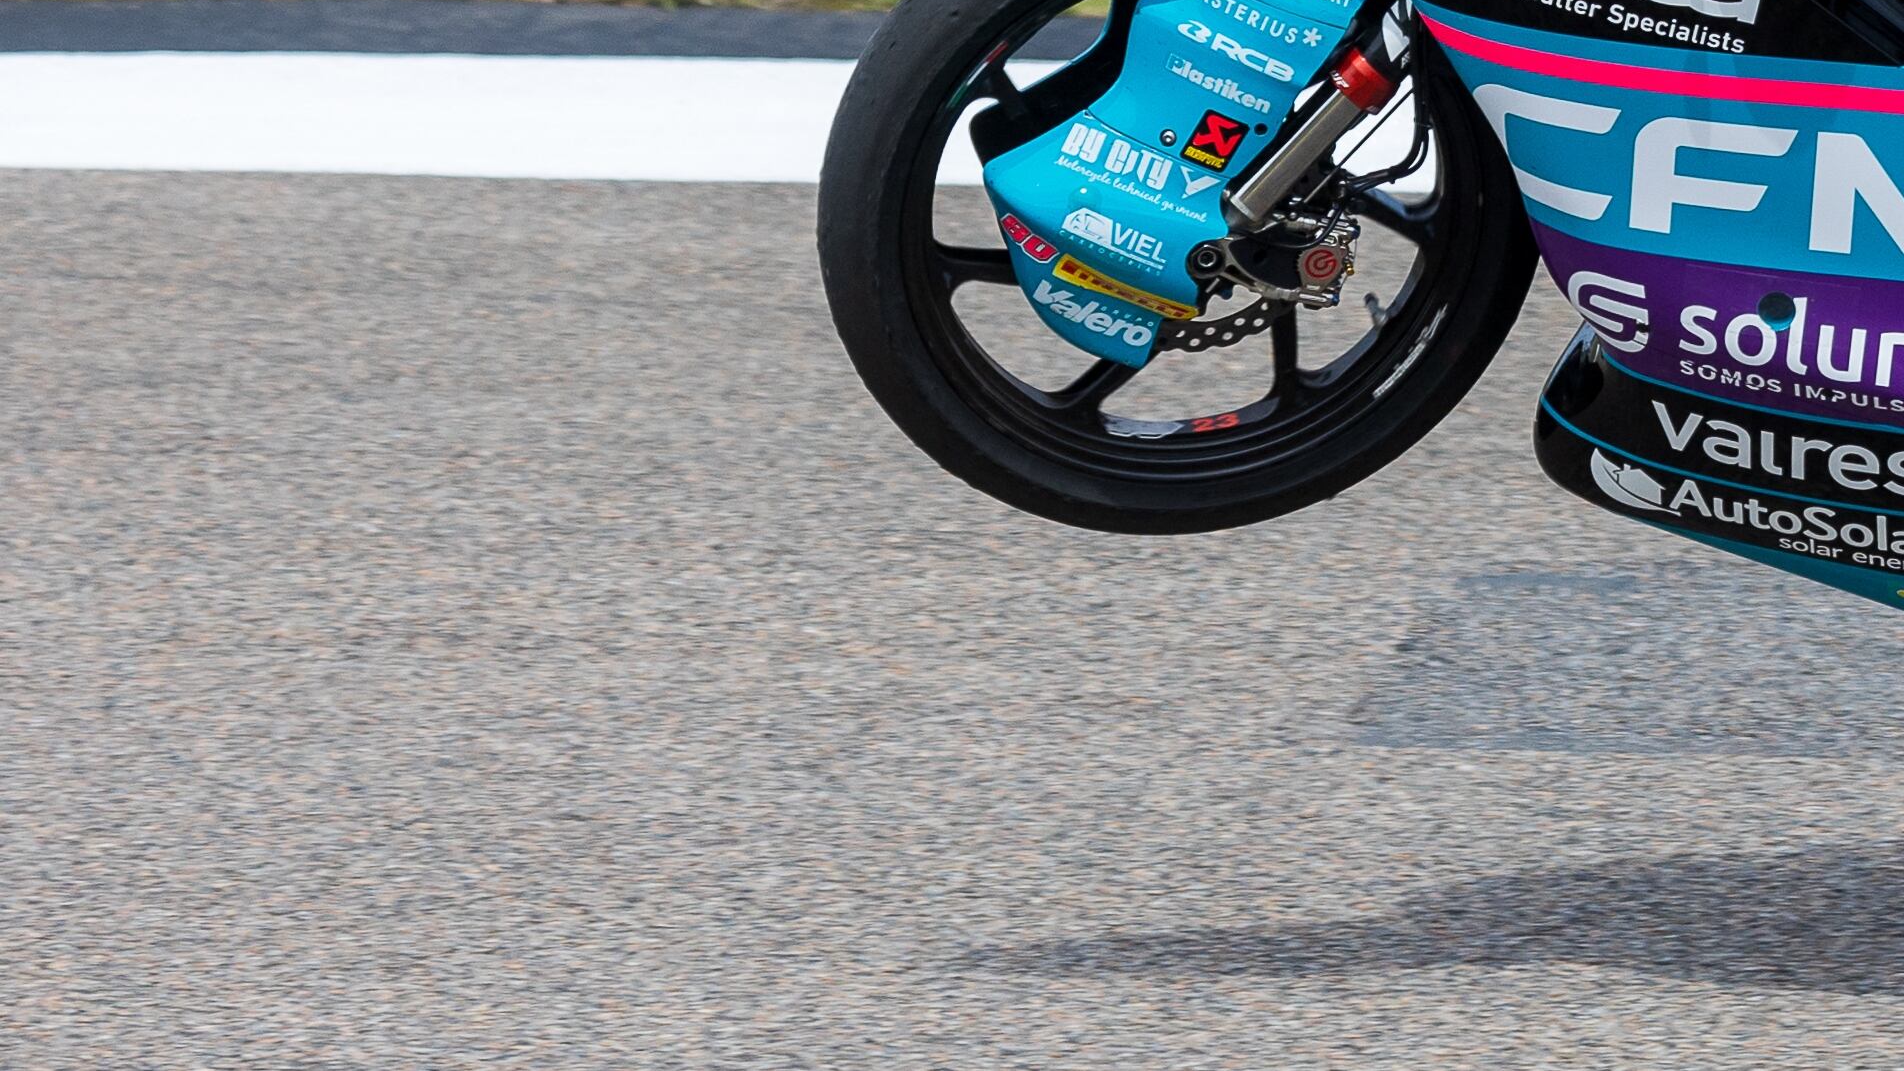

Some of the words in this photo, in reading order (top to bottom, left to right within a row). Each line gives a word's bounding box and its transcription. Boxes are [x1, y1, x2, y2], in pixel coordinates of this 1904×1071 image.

[1607, 4, 1746, 55] Specialists
[1211, 32, 1295, 82] RCB
[1166, 53, 1271, 114] Plastiken
[1054, 155, 1112, 185] Motorcycle
[1112, 178, 1161, 206] technical
[1161, 199, 1208, 223] garment
[1112, 222, 1168, 264] VIEL
[1033, 279, 1153, 347] Valero
[1678, 360, 1782, 395] SOMOS
[1191, 413, 1240, 432] 23
[1779, 536, 1843, 560] solar
